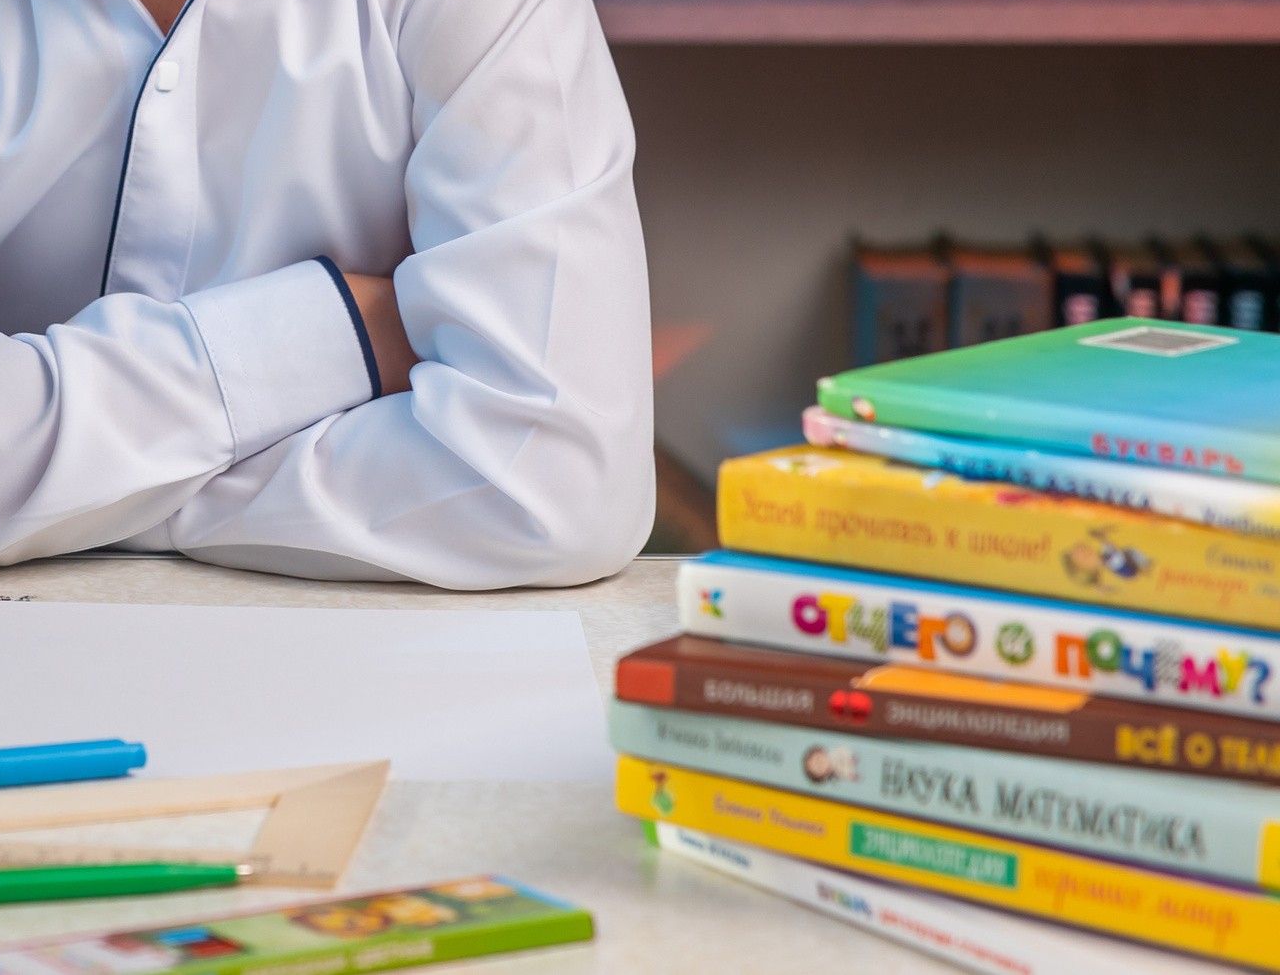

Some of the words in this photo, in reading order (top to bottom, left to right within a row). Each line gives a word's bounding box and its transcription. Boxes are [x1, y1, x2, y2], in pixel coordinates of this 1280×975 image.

[1091, 433, 1245, 475] БУКВАРЬ
[816, 508, 936, 548] прочитать
[791, 592, 978, 661] ОТЧЕГО
[1055, 628, 1270, 705] ПОЧЕМУ?
[704, 678, 814, 712] БОЛЬШАЯ
[885, 701, 1070, 744] ЭНЦИКЛОПЕДИЯ
[1115, 723, 1179, 767] ВСЁ
[1184, 732, 1216, 769] О
[880, 756, 981, 815] НАУКА
[994, 781, 1208, 861] МАТЕМАТИКА
[863, 827, 1008, 885] ЭНЦИКЛОПЕДИЯ
